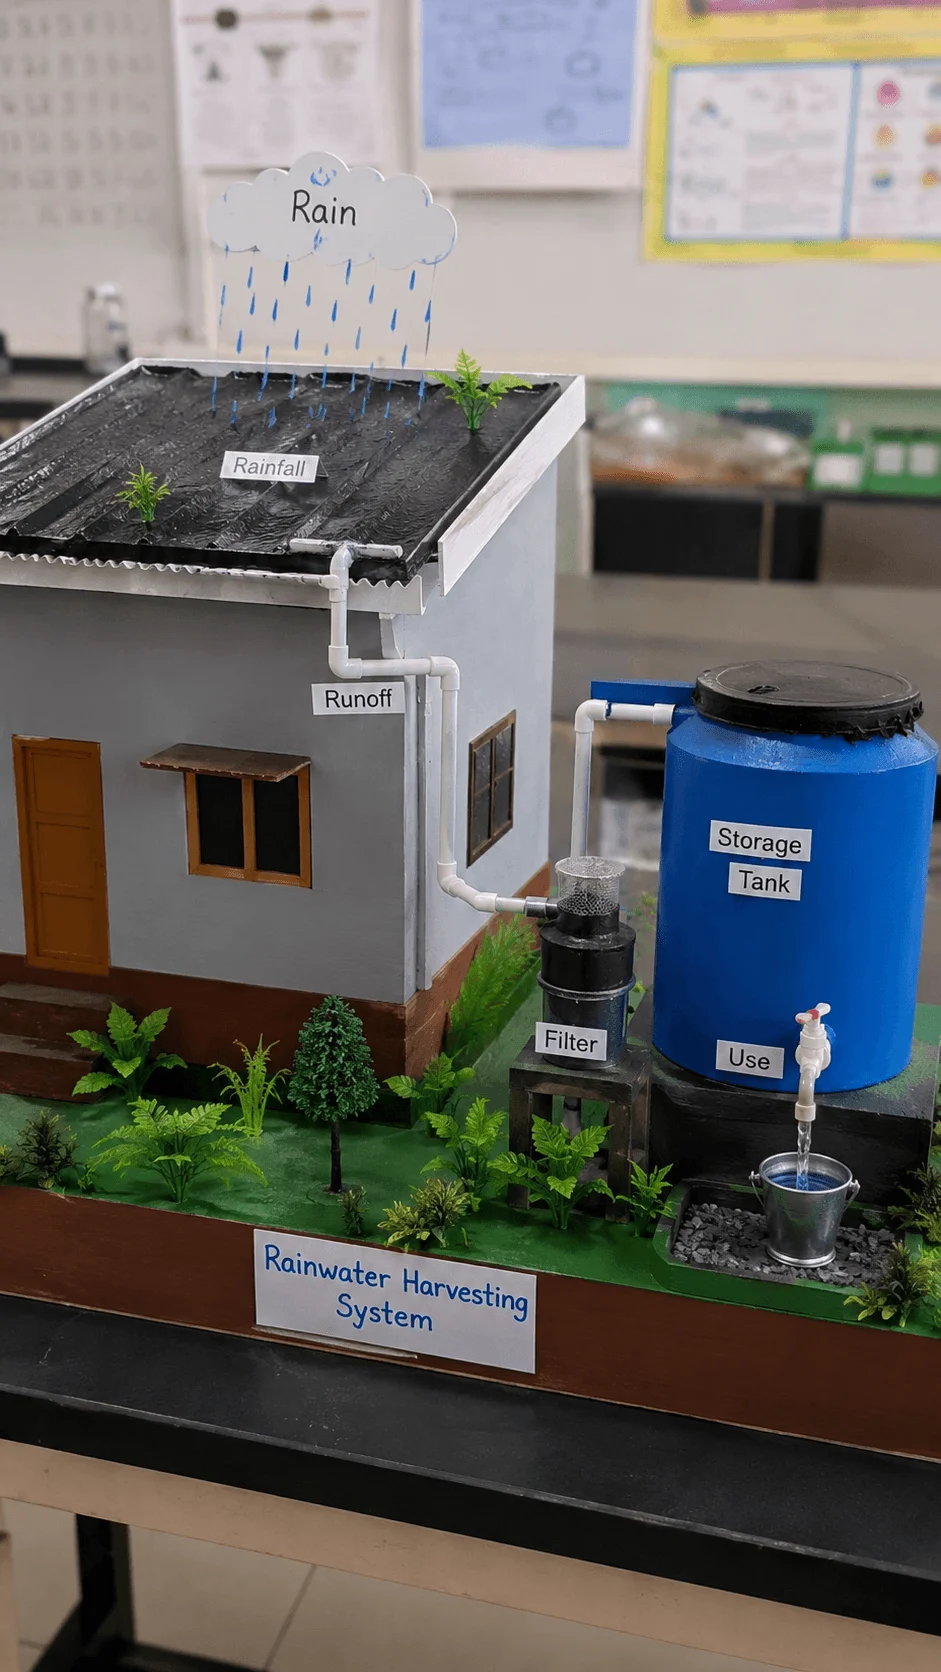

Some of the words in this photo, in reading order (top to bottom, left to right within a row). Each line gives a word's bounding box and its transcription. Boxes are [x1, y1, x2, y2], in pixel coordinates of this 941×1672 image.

[292, 189, 357, 226] Rain
[233, 456, 306, 477] Rainfall
[325, 688, 393, 708] Runoff
[717, 827, 803, 858] Storage
[739, 869, 790, 894] Tank
[545, 1030, 598, 1053] Filter
[729, 1048, 770, 1070] Use
[264, 1244, 391, 1288] Rainwater
[403, 1267, 528, 1323] Harvesting
[336, 1293, 433, 1331] System
